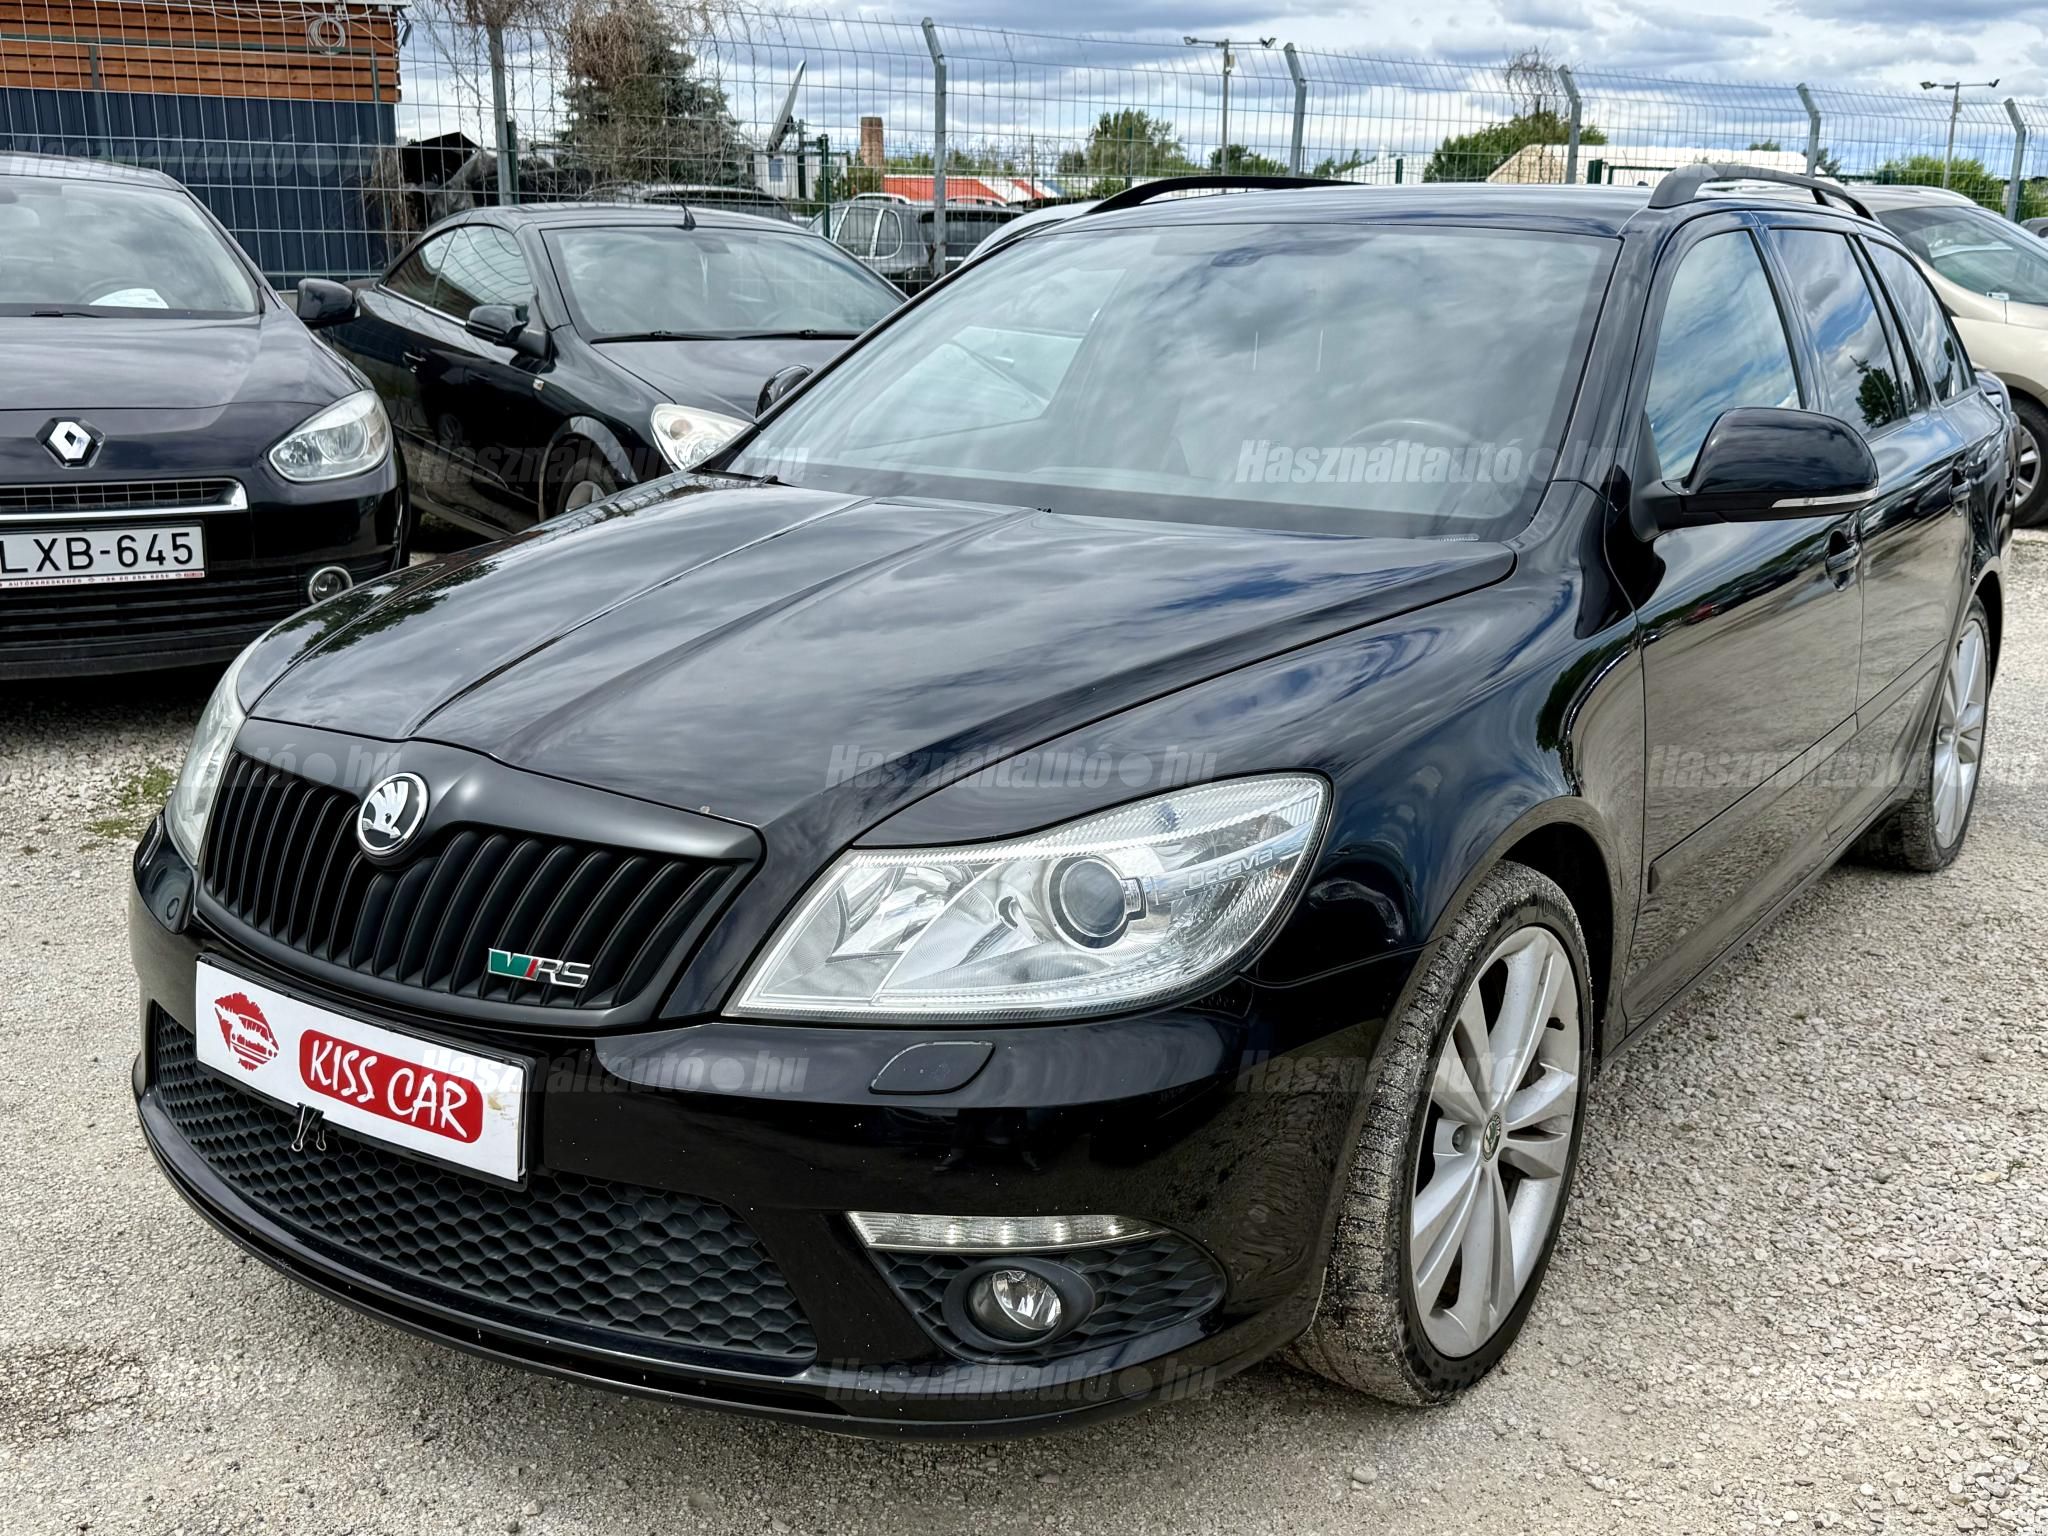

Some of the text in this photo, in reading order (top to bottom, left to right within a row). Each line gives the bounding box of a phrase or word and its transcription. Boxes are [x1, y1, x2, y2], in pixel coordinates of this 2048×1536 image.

[0, 532, 193, 574] LXB-645
[310, 1039, 468, 1139] KISS CAR
